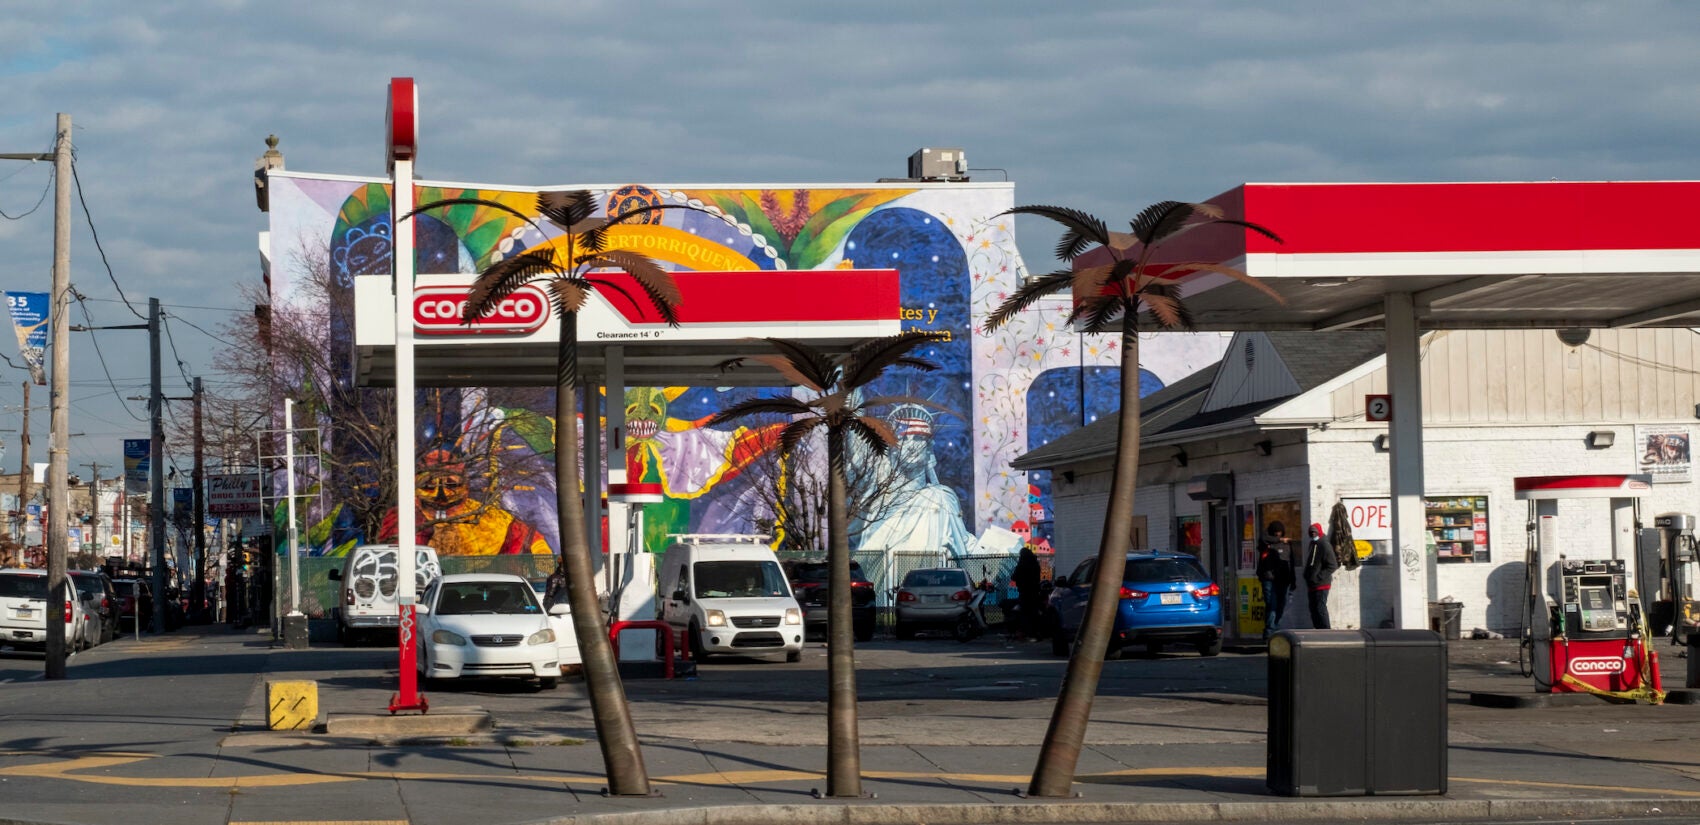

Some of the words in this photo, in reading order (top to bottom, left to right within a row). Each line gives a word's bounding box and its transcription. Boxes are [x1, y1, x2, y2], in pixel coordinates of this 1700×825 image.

[7, 296, 28, 307] 35
[927, 309, 938, 324] y
[1375, 403, 1384, 414] 2
[212, 478, 248, 491] Philly
[1351, 505, 1392, 528] OPE
[1574, 660, 1622, 671] conoco
